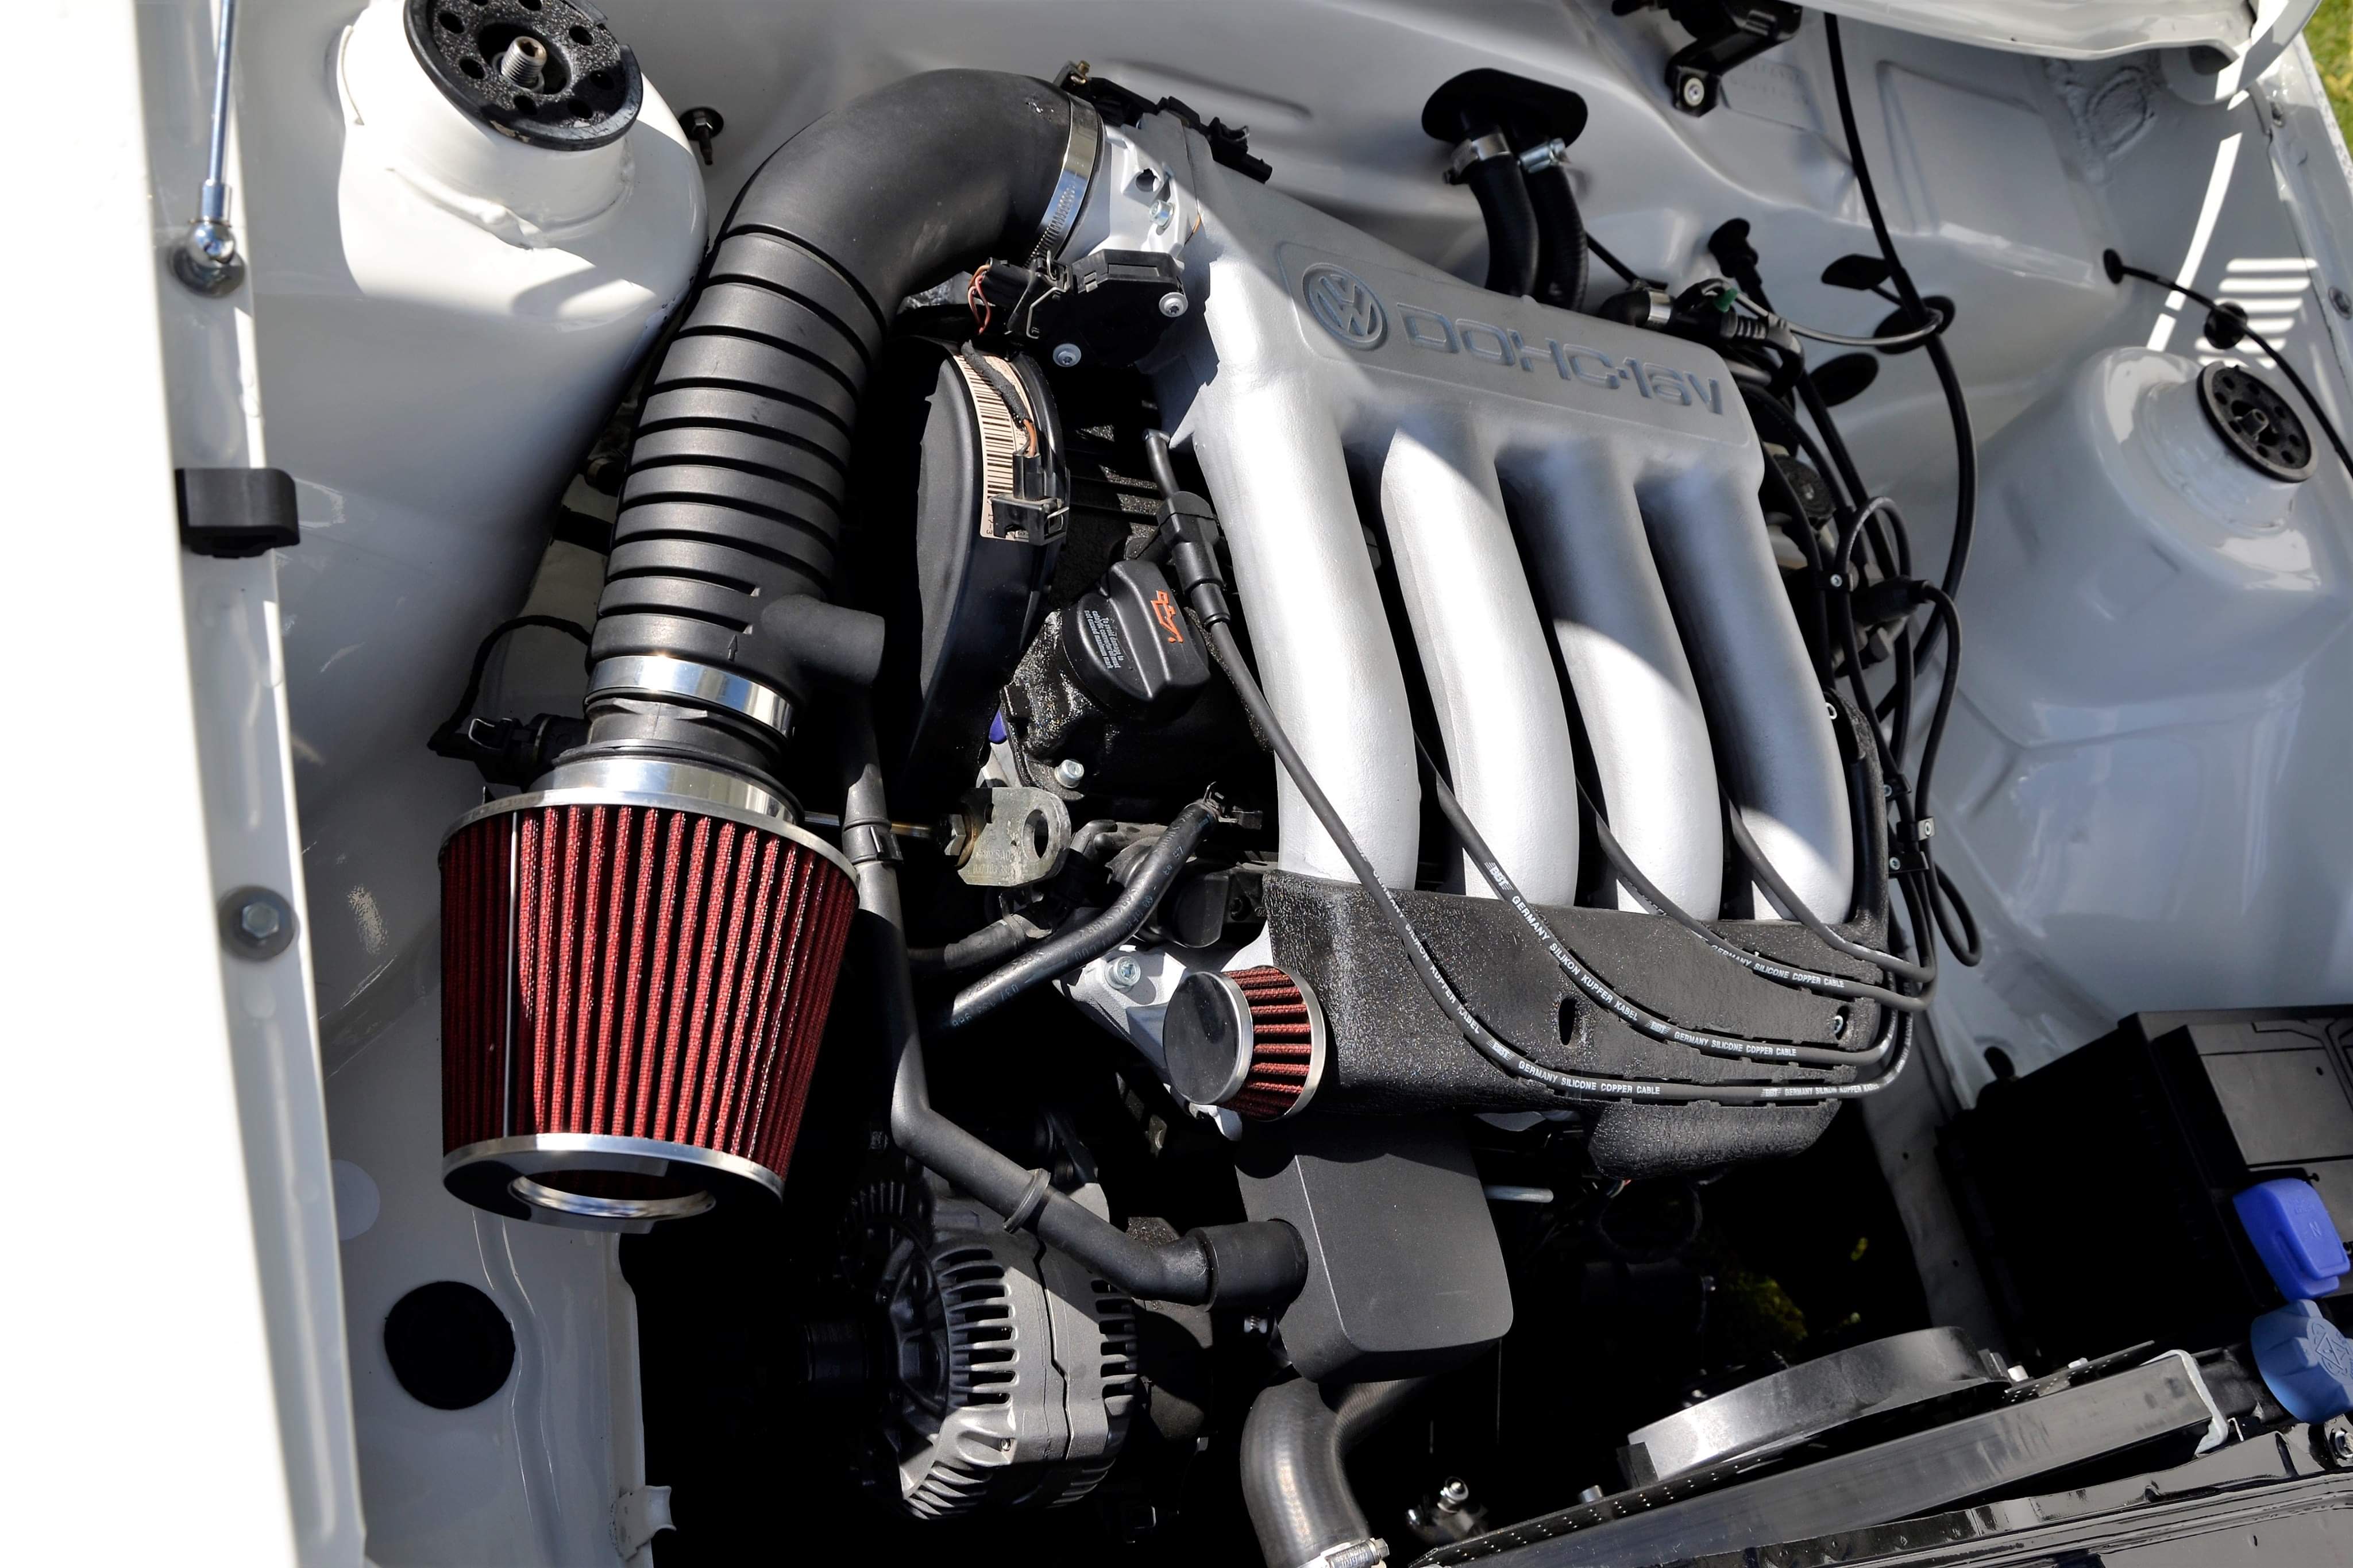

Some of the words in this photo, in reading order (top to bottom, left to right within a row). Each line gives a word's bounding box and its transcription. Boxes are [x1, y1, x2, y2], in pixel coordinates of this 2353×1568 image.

[1430, 964, 1457, 1004] KUPFER
[1457, 1005, 1480, 1034] KABEL
[1518, 1060, 1558, 1083] GERMANY
[1561, 1077, 1597, 1091] SILICONE
[1601, 1082, 1633, 1094] COPPER
[1637, 1086, 1660, 1095] CABLE
[1784, 1087, 1813, 1096] GERMANY
[1512, 895, 1550, 940] GERMANY
[1550, 943, 1581, 975] SILIKON
[1581, 974, 1614, 1003] KUPFER
[1614, 1001, 1638, 1021] KABEL
[1674, 1031, 1708, 1047] GERMANY
[1711, 1040, 1743, 1052] SILICONE
[1746, 1044, 1773, 1056] COPPER
[1776, 1047, 1797, 1056] CABLE
[1753, 962, 1790, 979] SILICONE
[1792, 972, 1821, 984] COPPER
[1824, 978, 1845, 988] CABLE
